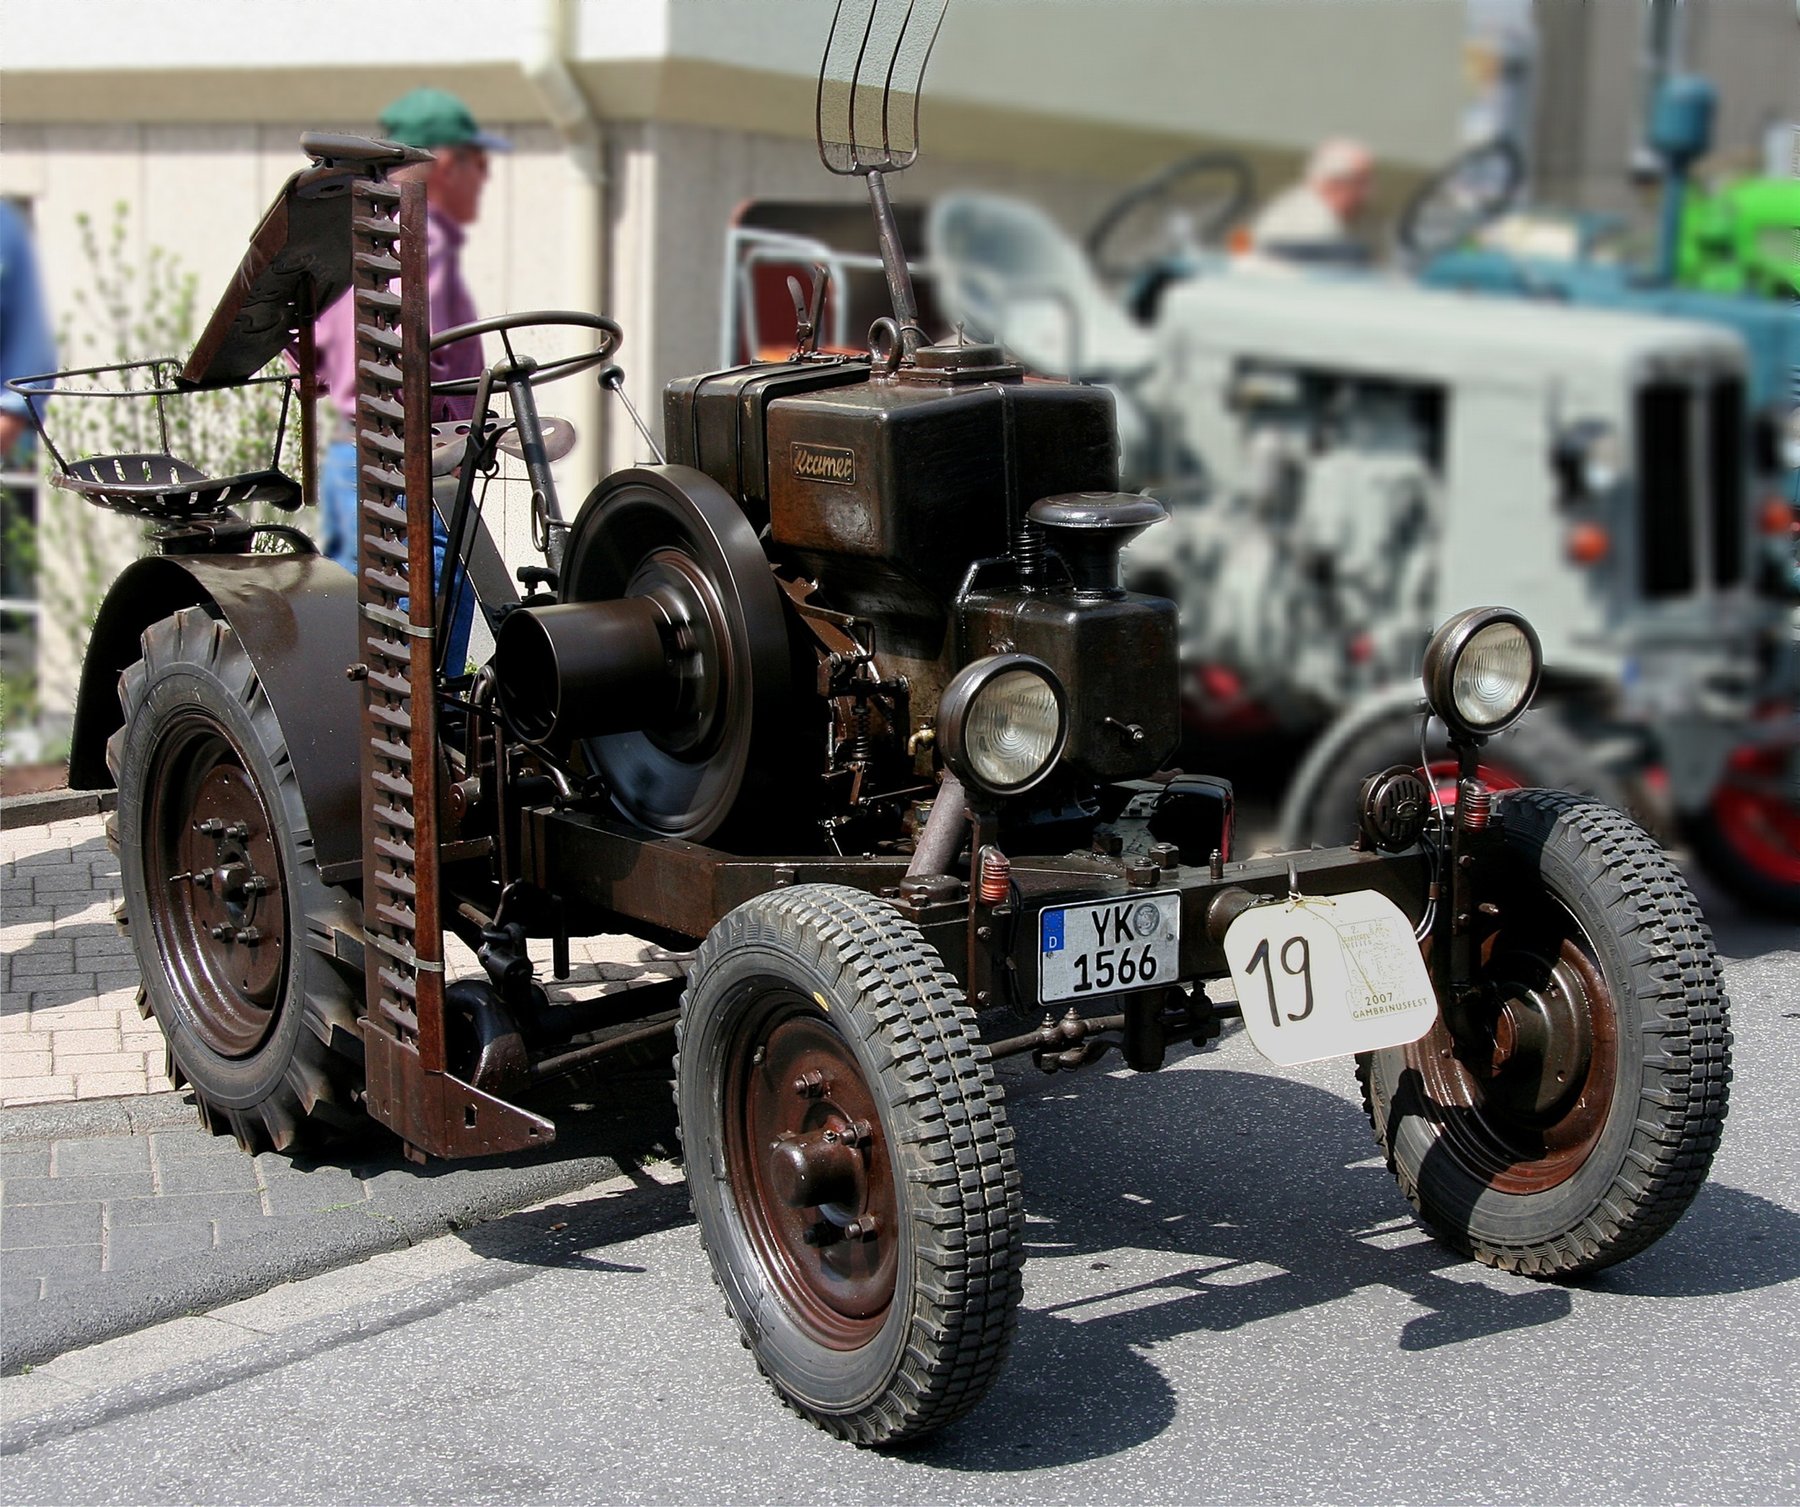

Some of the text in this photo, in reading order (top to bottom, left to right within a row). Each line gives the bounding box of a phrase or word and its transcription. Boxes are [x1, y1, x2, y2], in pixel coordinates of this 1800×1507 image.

[793, 450, 852, 478] Kramer
[1091, 903, 1135, 947] YK
[1049, 936, 1058, 949] D
[1073, 943, 1157, 992] 1566
[1245, 936, 1314, 1028] 19
[1352, 998, 1428, 1019] GAMBRINUSFEST
[1365, 992, 1393, 1007] 2007
